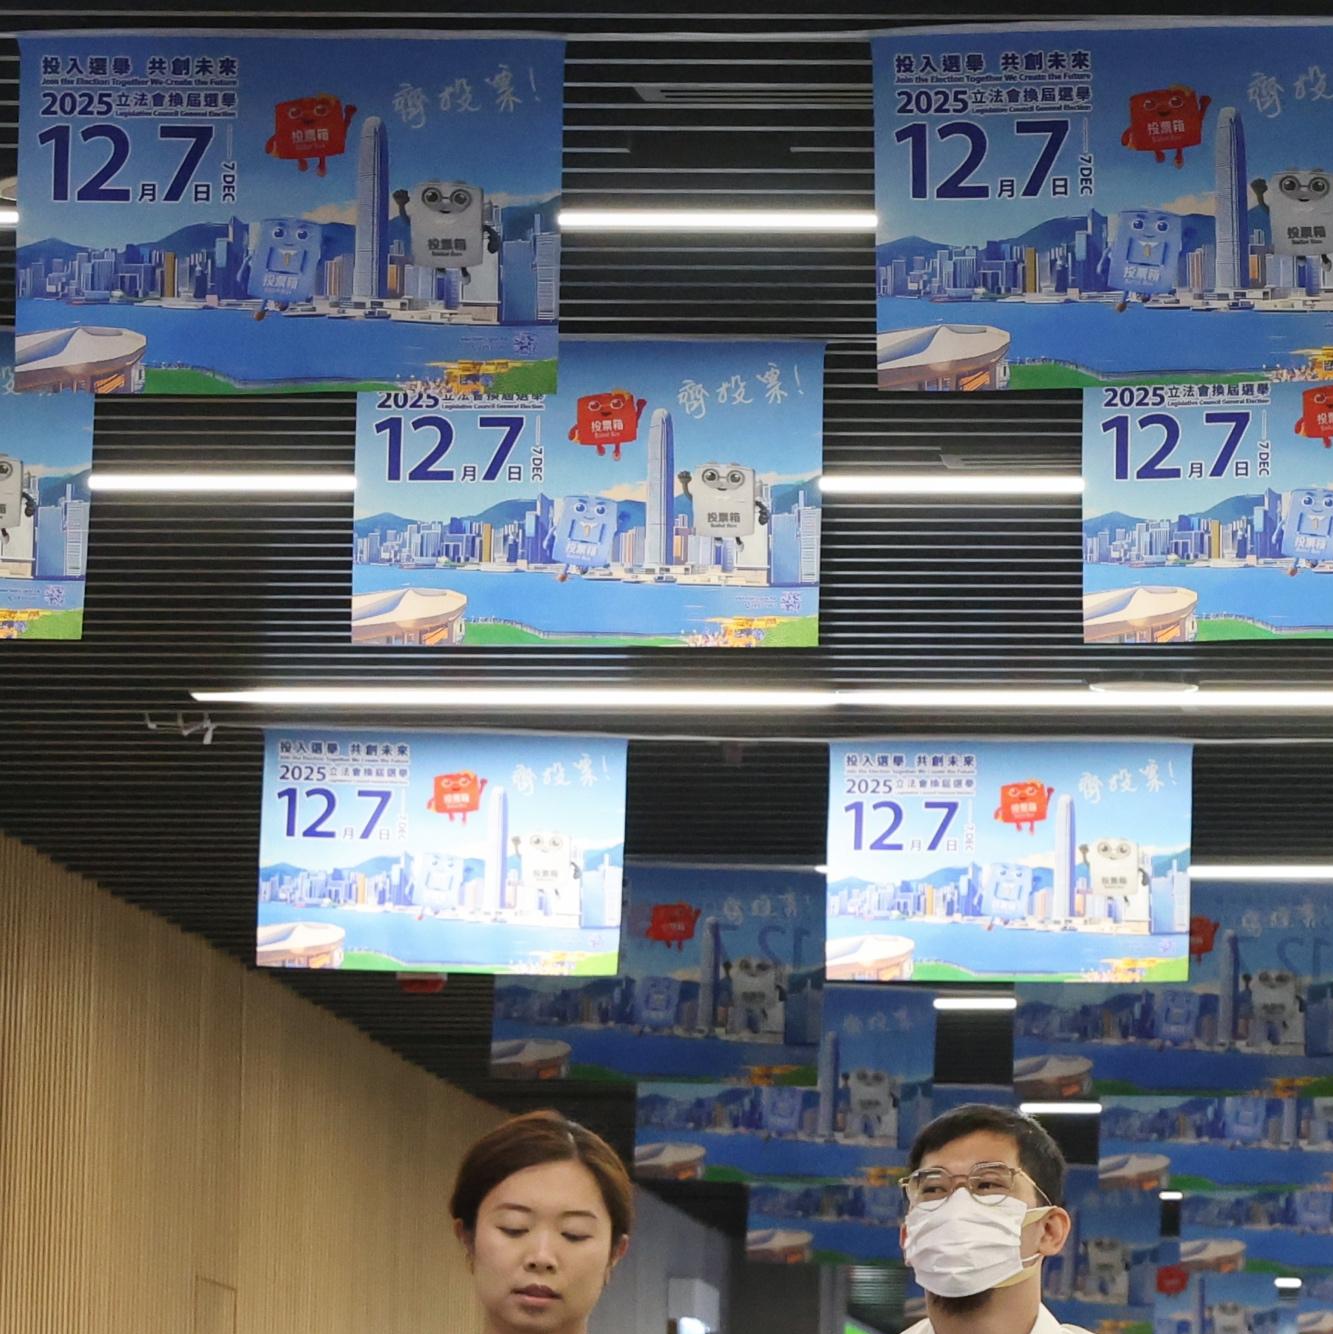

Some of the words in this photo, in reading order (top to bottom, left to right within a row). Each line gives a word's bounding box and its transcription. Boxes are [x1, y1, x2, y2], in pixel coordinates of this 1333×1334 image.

[42, 58, 131, 76] 投入選舉
[149, 57, 236, 76] 共創未來
[896, 55, 984, 74] 投入選舉
[1002, 51, 1089, 71] 共創未來
[41, 93, 113, 116] 2025
[116, 93, 236, 108] 立法會換屆選舉
[896, 90, 969, 115] 2025
[971, 87, 1091, 104] 立法會換屆選舉
[1148, 119, 1186, 135] 投票箱
[222, 173, 235, 201] DEC
[1080, 167, 1093, 195] DEC
[1287, 225, 1326, 239] 投票箱
[428, 238, 466, 251] 投票箱
[1104, 387, 1165, 408] 2025
[1168, 384, 1269, 398] 立法會換屆選舉
[591, 418, 624, 431] 投票箱
[532, 457, 543, 481] DEC
[1259, 451, 1270, 476] DEC
[707, 512, 740, 523] 投票箱
[278, 766, 327, 781] 2025
[845, 778, 893, 794] 2025
